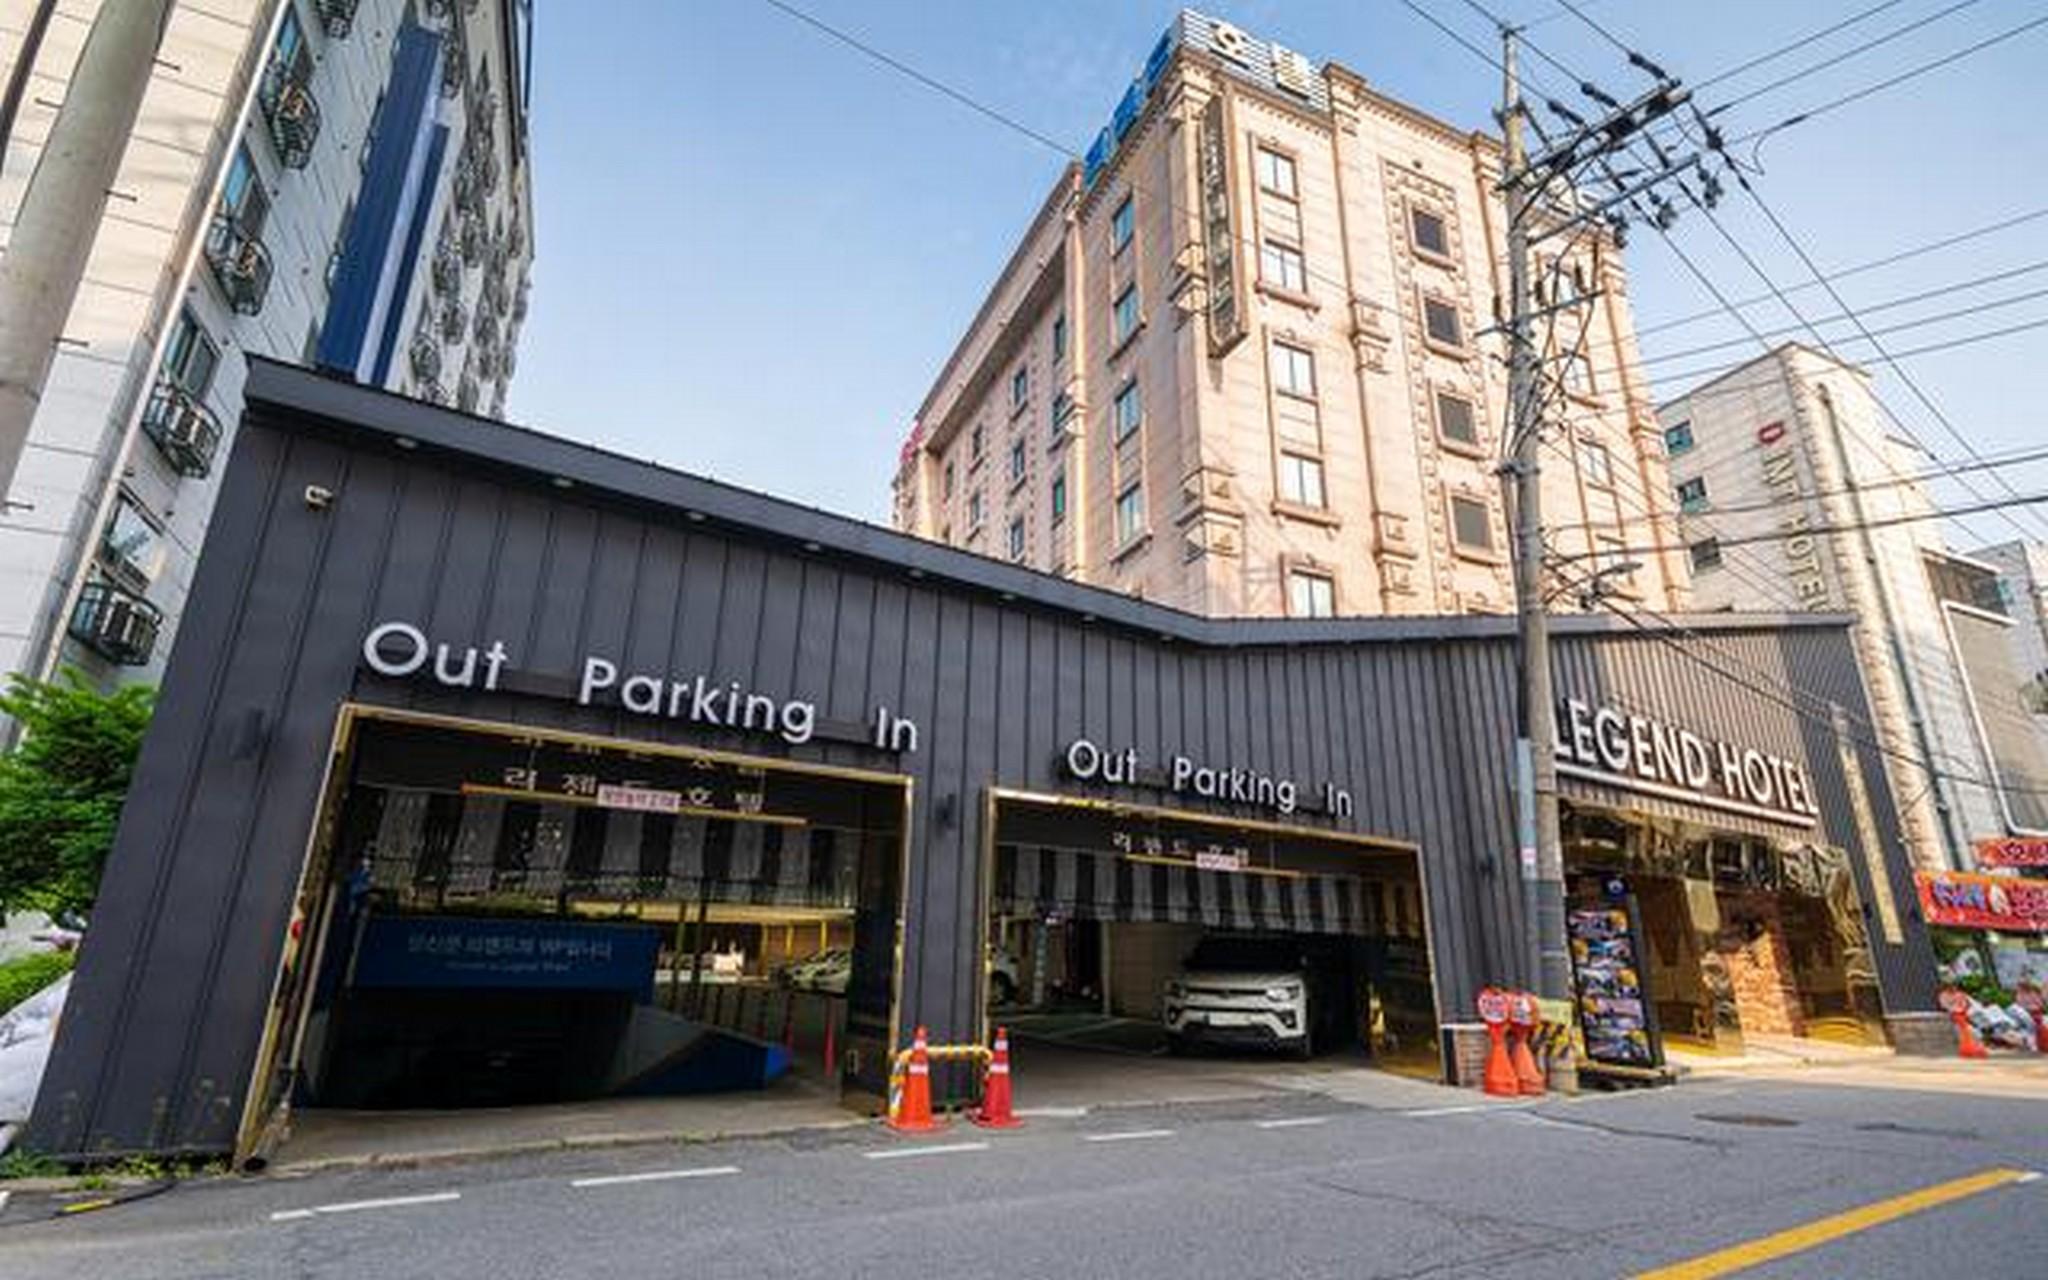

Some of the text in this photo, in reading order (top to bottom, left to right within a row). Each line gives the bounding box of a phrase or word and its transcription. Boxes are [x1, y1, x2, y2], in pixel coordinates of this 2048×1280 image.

[363, 621, 919, 753] Out Parking In
[1067, 738, 1352, 817] Out Parking In
[1550, 695, 1820, 815] LEGEND HOTEL
